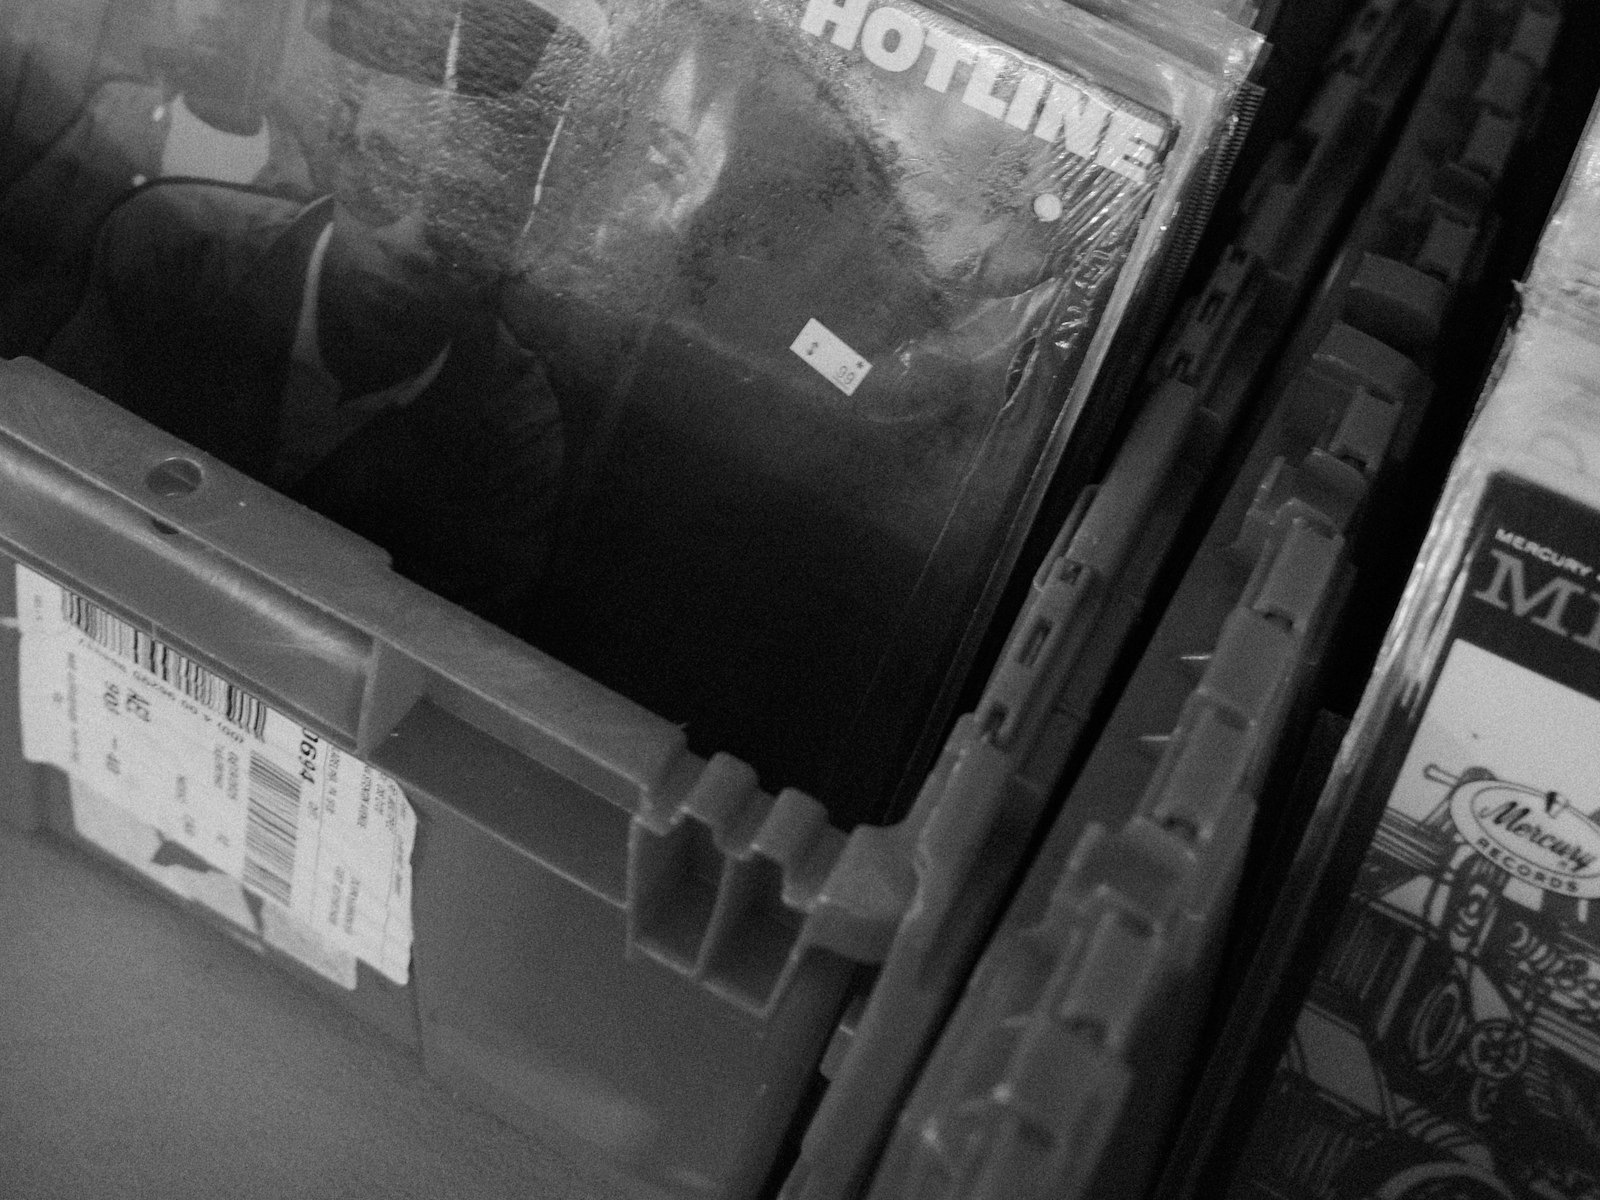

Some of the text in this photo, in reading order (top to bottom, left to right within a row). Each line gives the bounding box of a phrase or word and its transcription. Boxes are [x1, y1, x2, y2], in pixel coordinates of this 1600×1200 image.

[1495, 528, 1594, 577] MERCURY
[1480, 800, 1597, 873] Mercury
[1477, 837, 1579, 894] RECORDS
